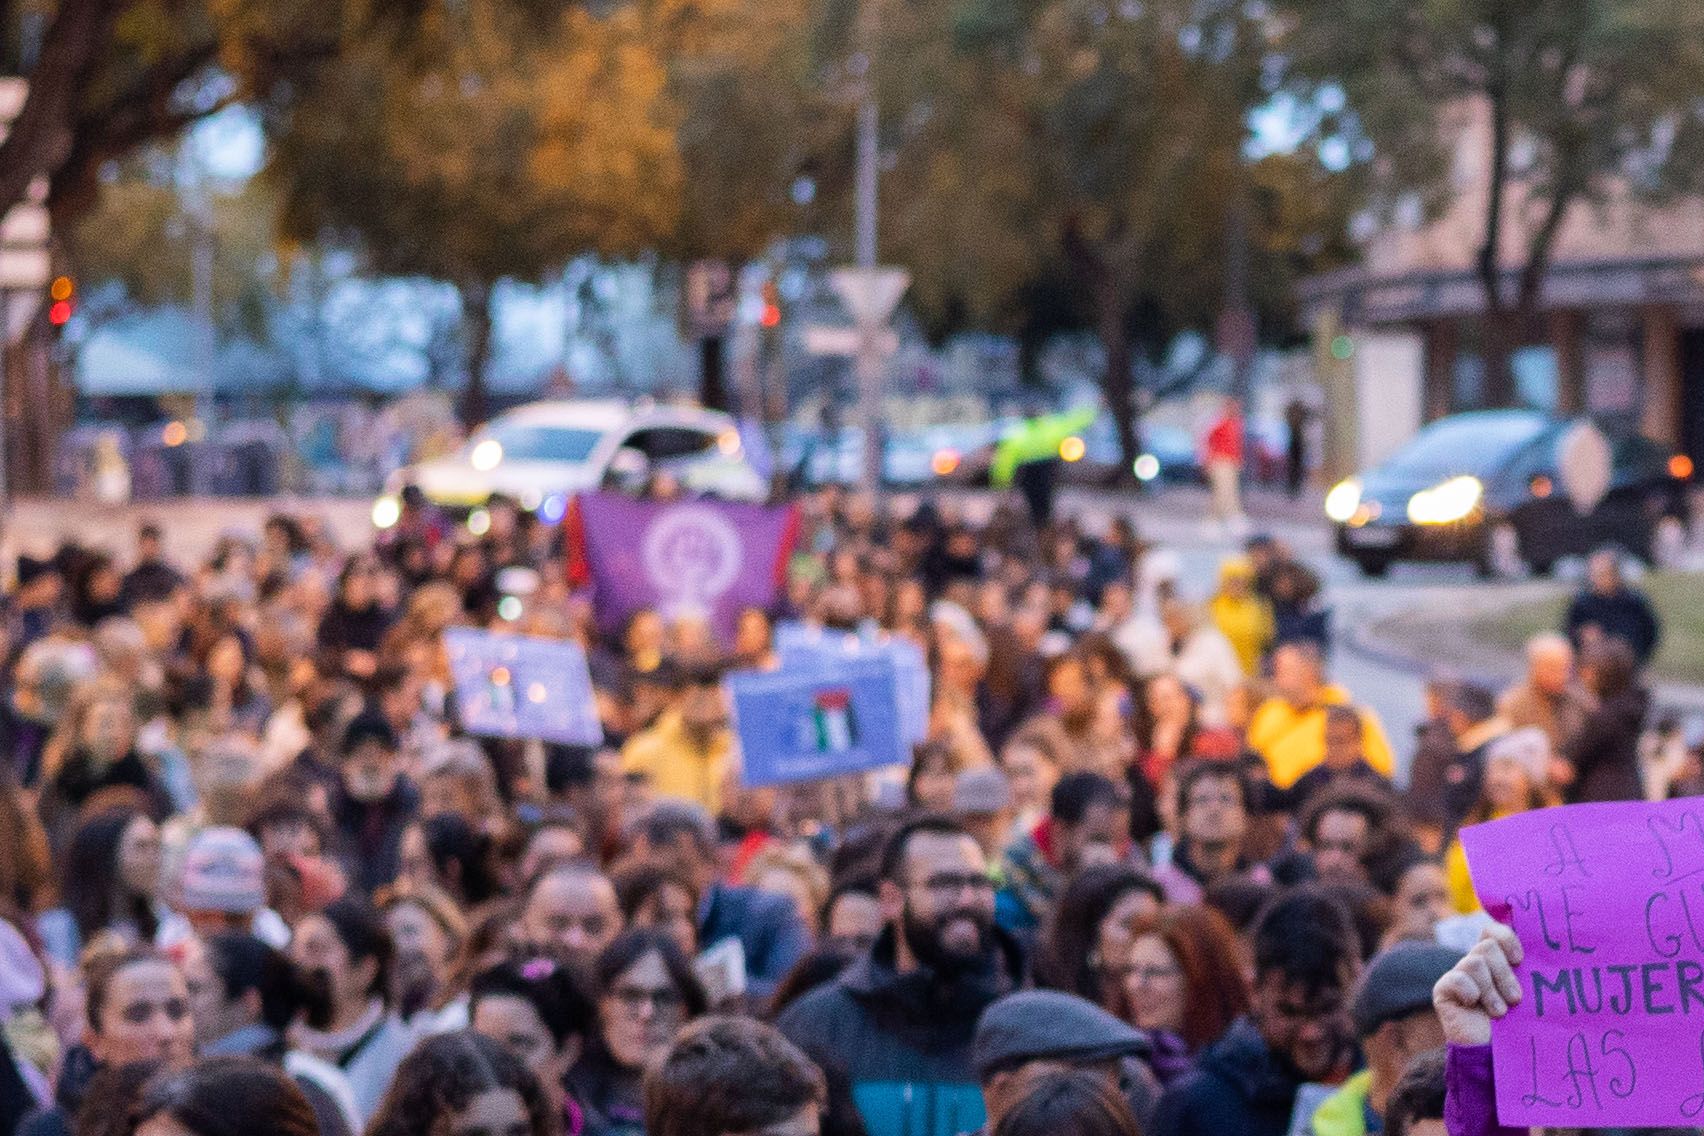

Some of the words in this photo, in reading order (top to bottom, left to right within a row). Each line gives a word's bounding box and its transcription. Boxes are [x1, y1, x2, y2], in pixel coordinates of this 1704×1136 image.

[1543, 822, 1592, 878] A
[1508, 883, 1597, 955] ME
[1521, 1028, 1636, 1111] LAS
